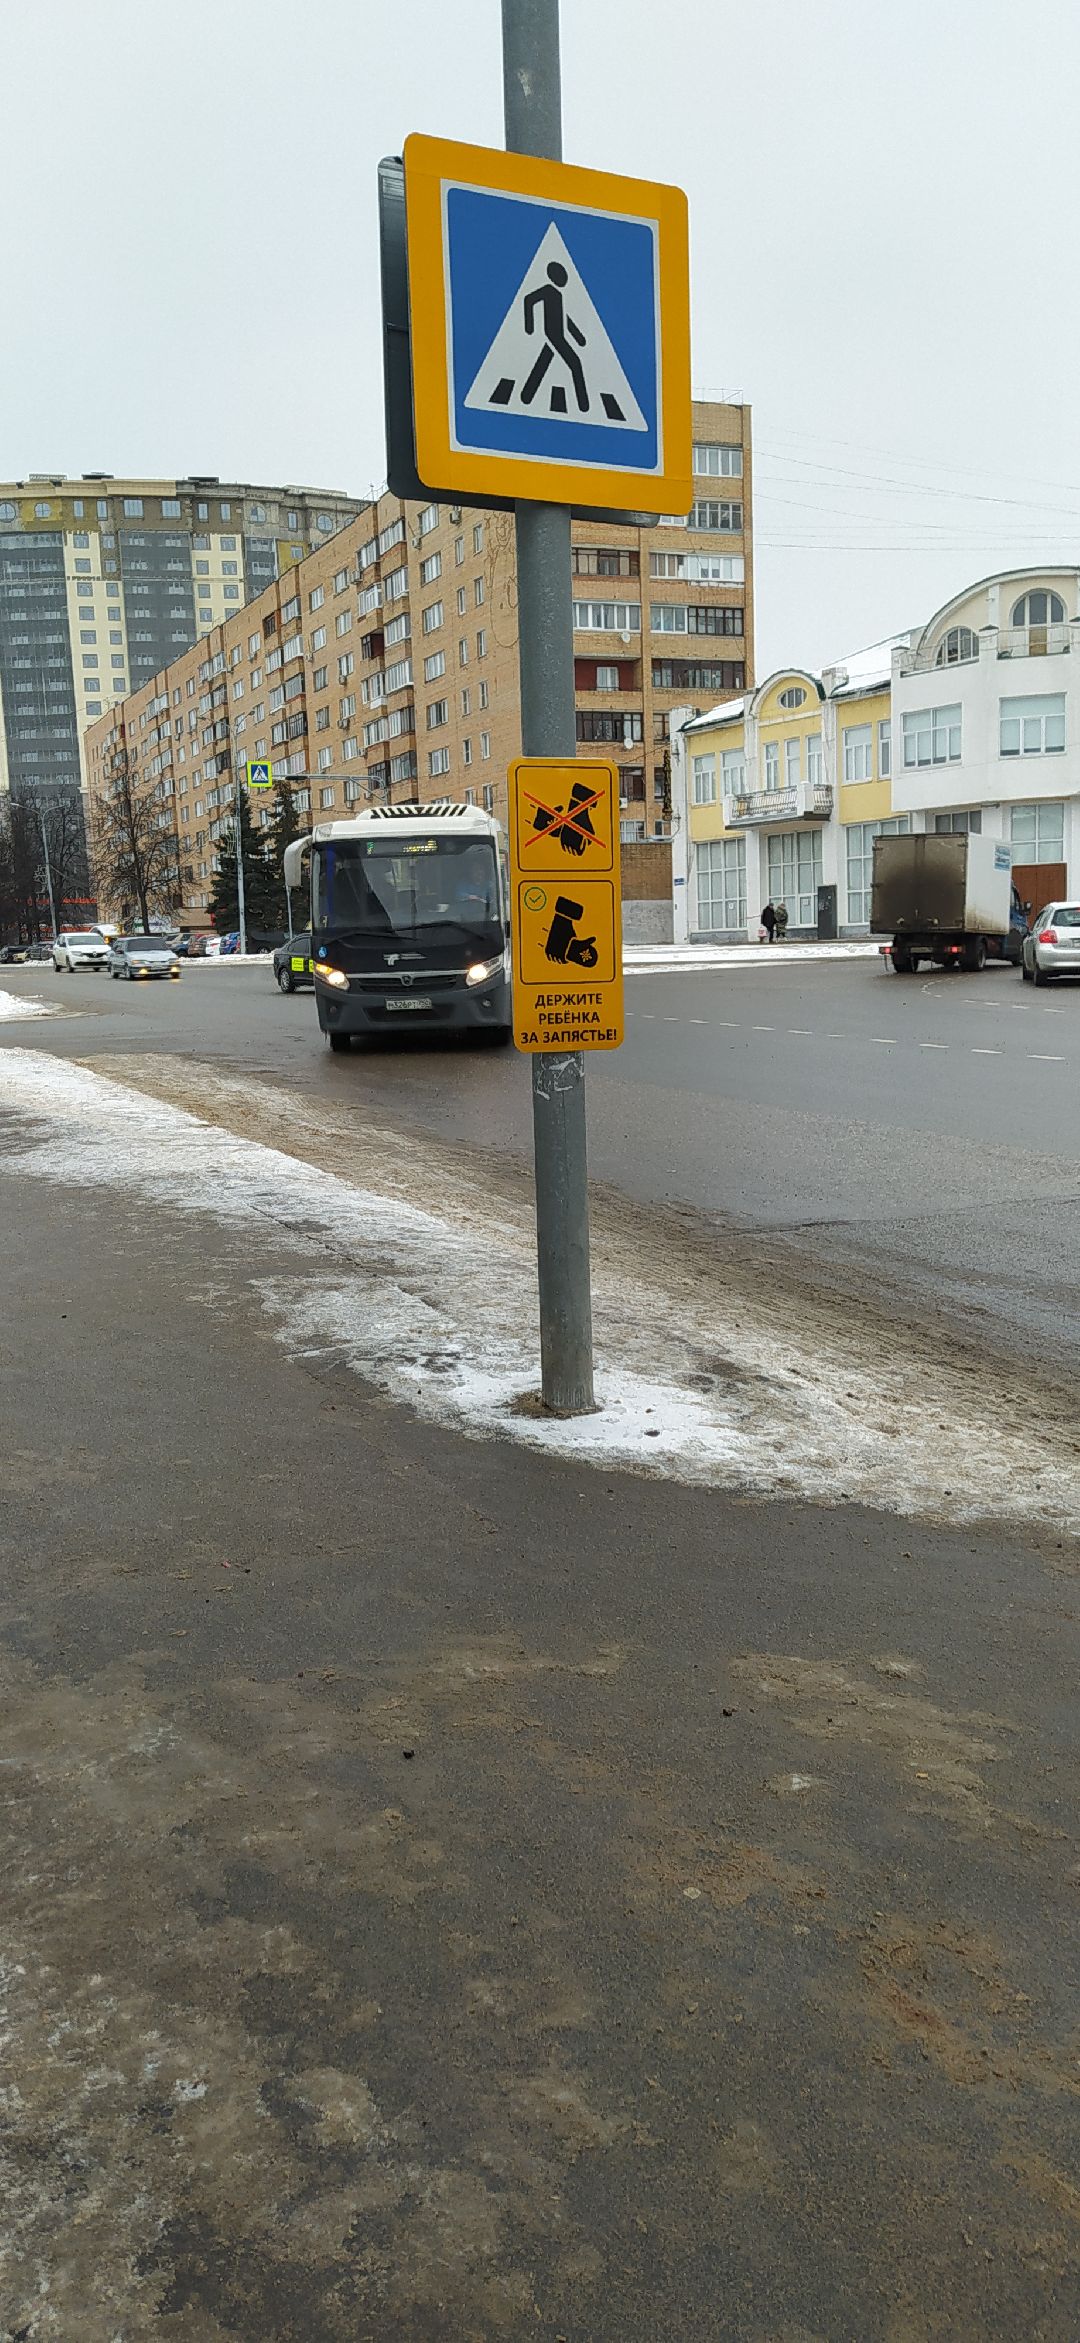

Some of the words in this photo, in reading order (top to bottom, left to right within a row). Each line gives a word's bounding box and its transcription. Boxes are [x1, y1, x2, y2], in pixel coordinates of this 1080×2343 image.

[535, 993, 603, 1009] ДЕРЖИТЕ
[539, 1010, 600, 1025] РЕБЁНКА
[521, 1032, 538, 1044] ЗА
[543, 1029, 617, 1043] ЗАПЯСТЬЕ!
